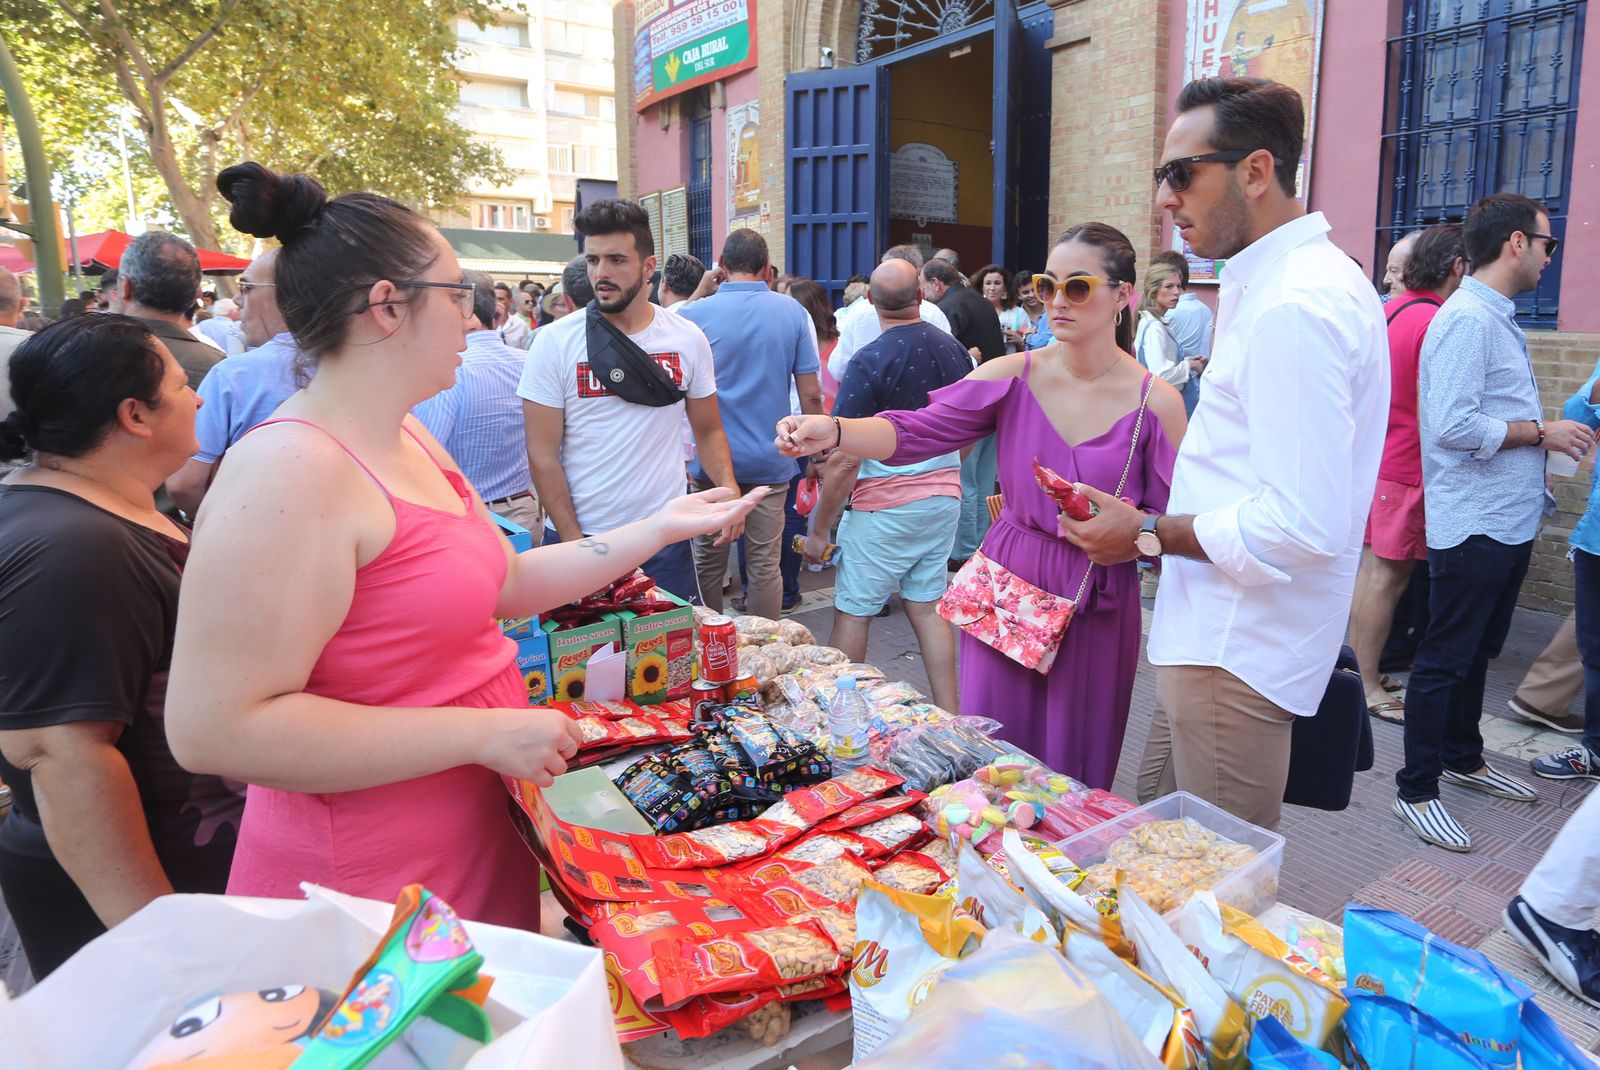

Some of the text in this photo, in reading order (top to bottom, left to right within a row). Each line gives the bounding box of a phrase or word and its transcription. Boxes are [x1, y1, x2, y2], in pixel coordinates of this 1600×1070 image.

[671, 22, 688, 35] 959
[691, 15, 703, 26] 28
[707, 8, 719, 19] 15
[723, 0, 737, 12] 00
[691, 3, 709, 15] LOS
[682, 36, 729, 65] CAJA RURAL
[1202, 0, 1219, 80] HUE
[694, 57, 715, 72] DEL SUR
[634, 615, 688, 633] frutos secos
[557, 628, 616, 647] frutos secos
[634, 634, 665, 657] Reyes
[558, 647, 591, 671] Reyes
[1254, 989, 1295, 1026] PATATAS
